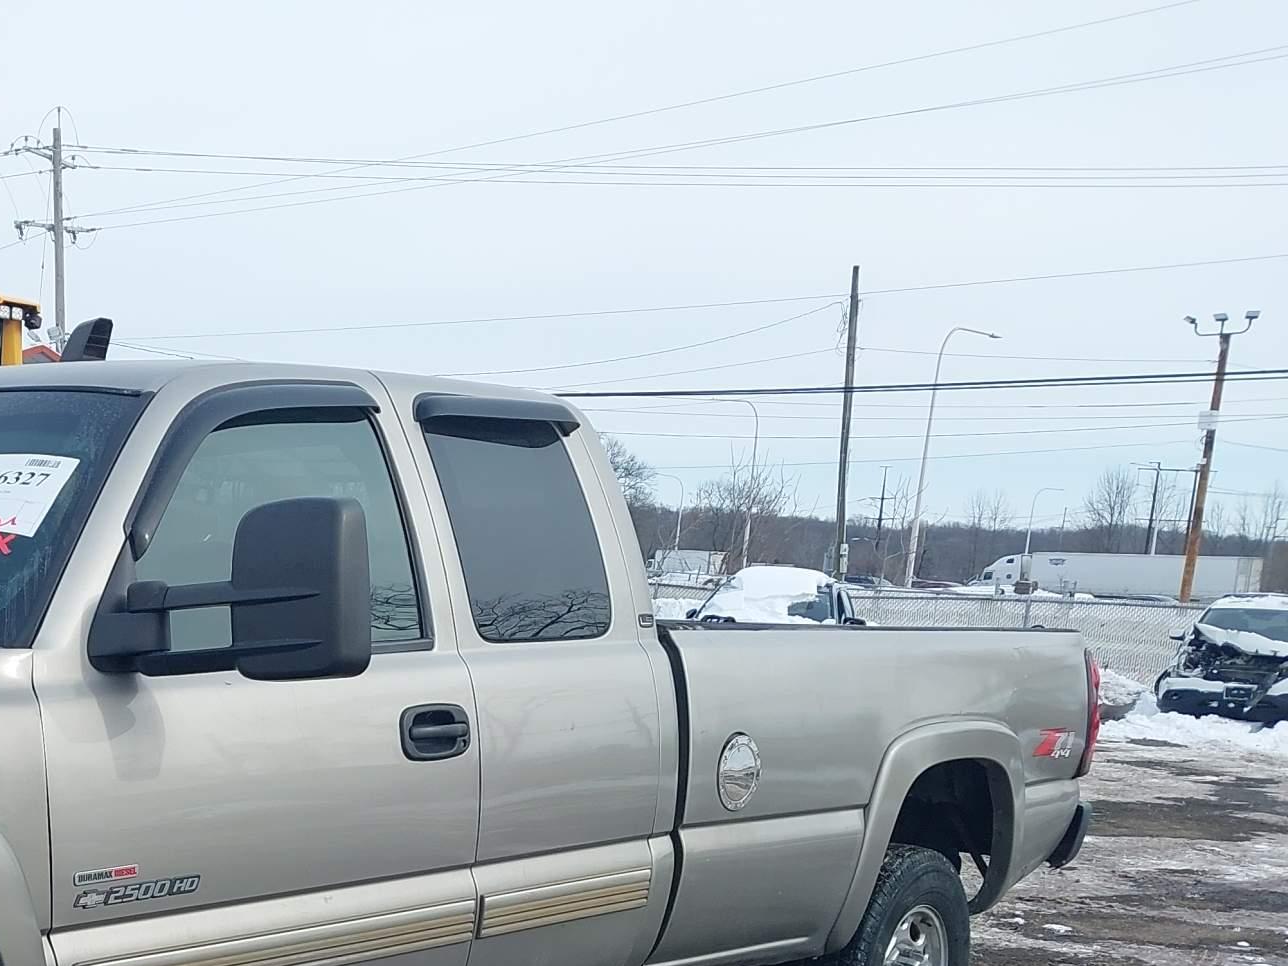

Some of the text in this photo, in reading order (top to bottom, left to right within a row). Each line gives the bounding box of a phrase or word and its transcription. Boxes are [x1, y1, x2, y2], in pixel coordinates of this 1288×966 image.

[78, 867, 137, 883] DURAMAX DIESEL
[109, 878, 197, 903] 2500 HD
